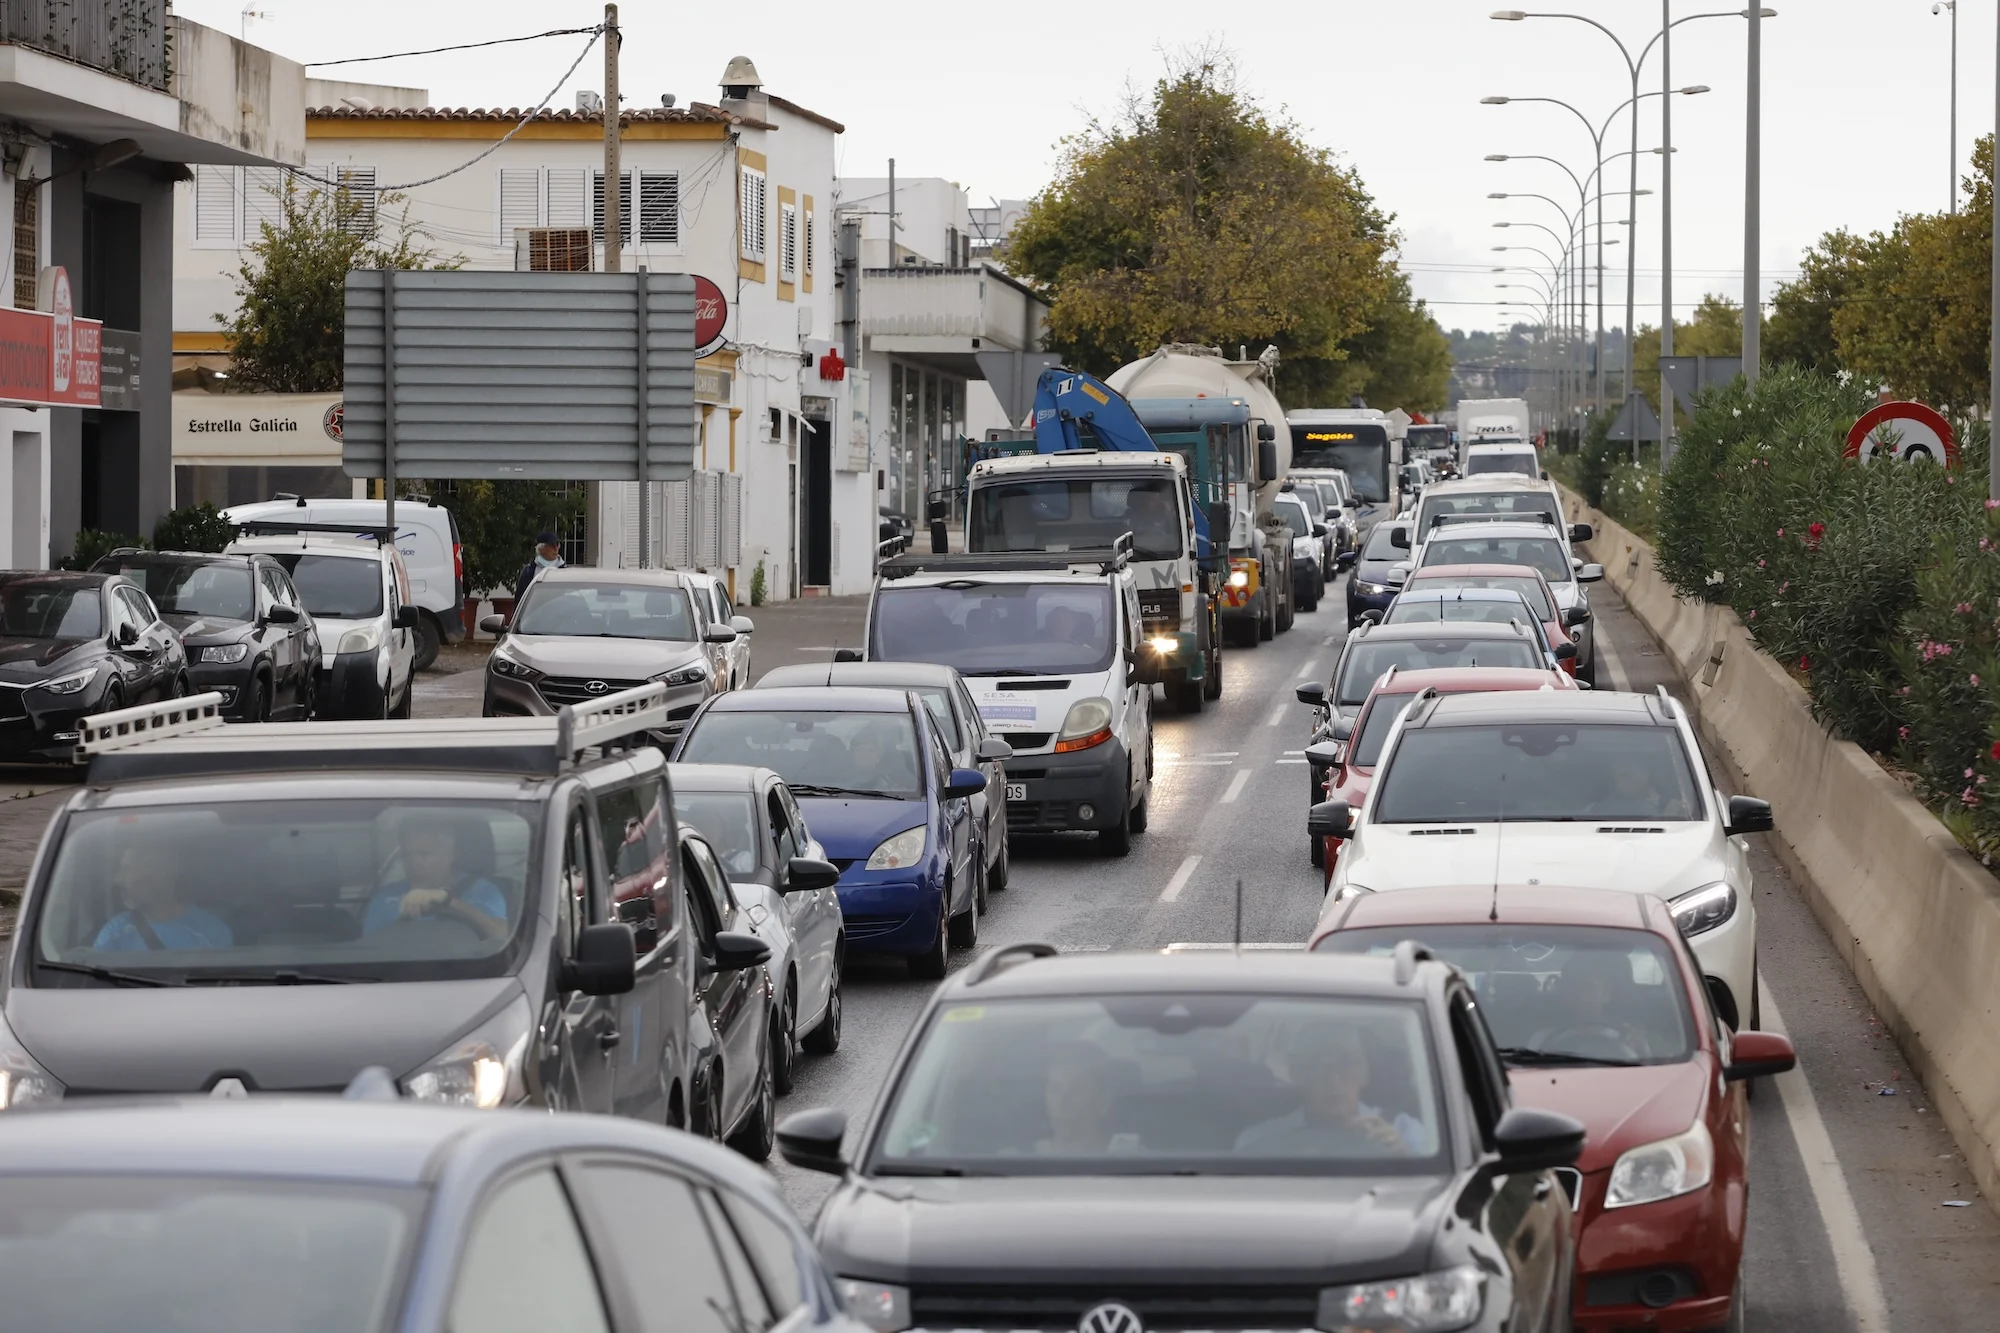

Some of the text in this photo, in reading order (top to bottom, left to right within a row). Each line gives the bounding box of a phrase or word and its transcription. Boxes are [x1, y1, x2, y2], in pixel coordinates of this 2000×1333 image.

[188, 418, 298, 432] Estrella Galicia
[1476, 425, 1514, 433] TRIAS
[1141, 604, 1161, 614] FL6
